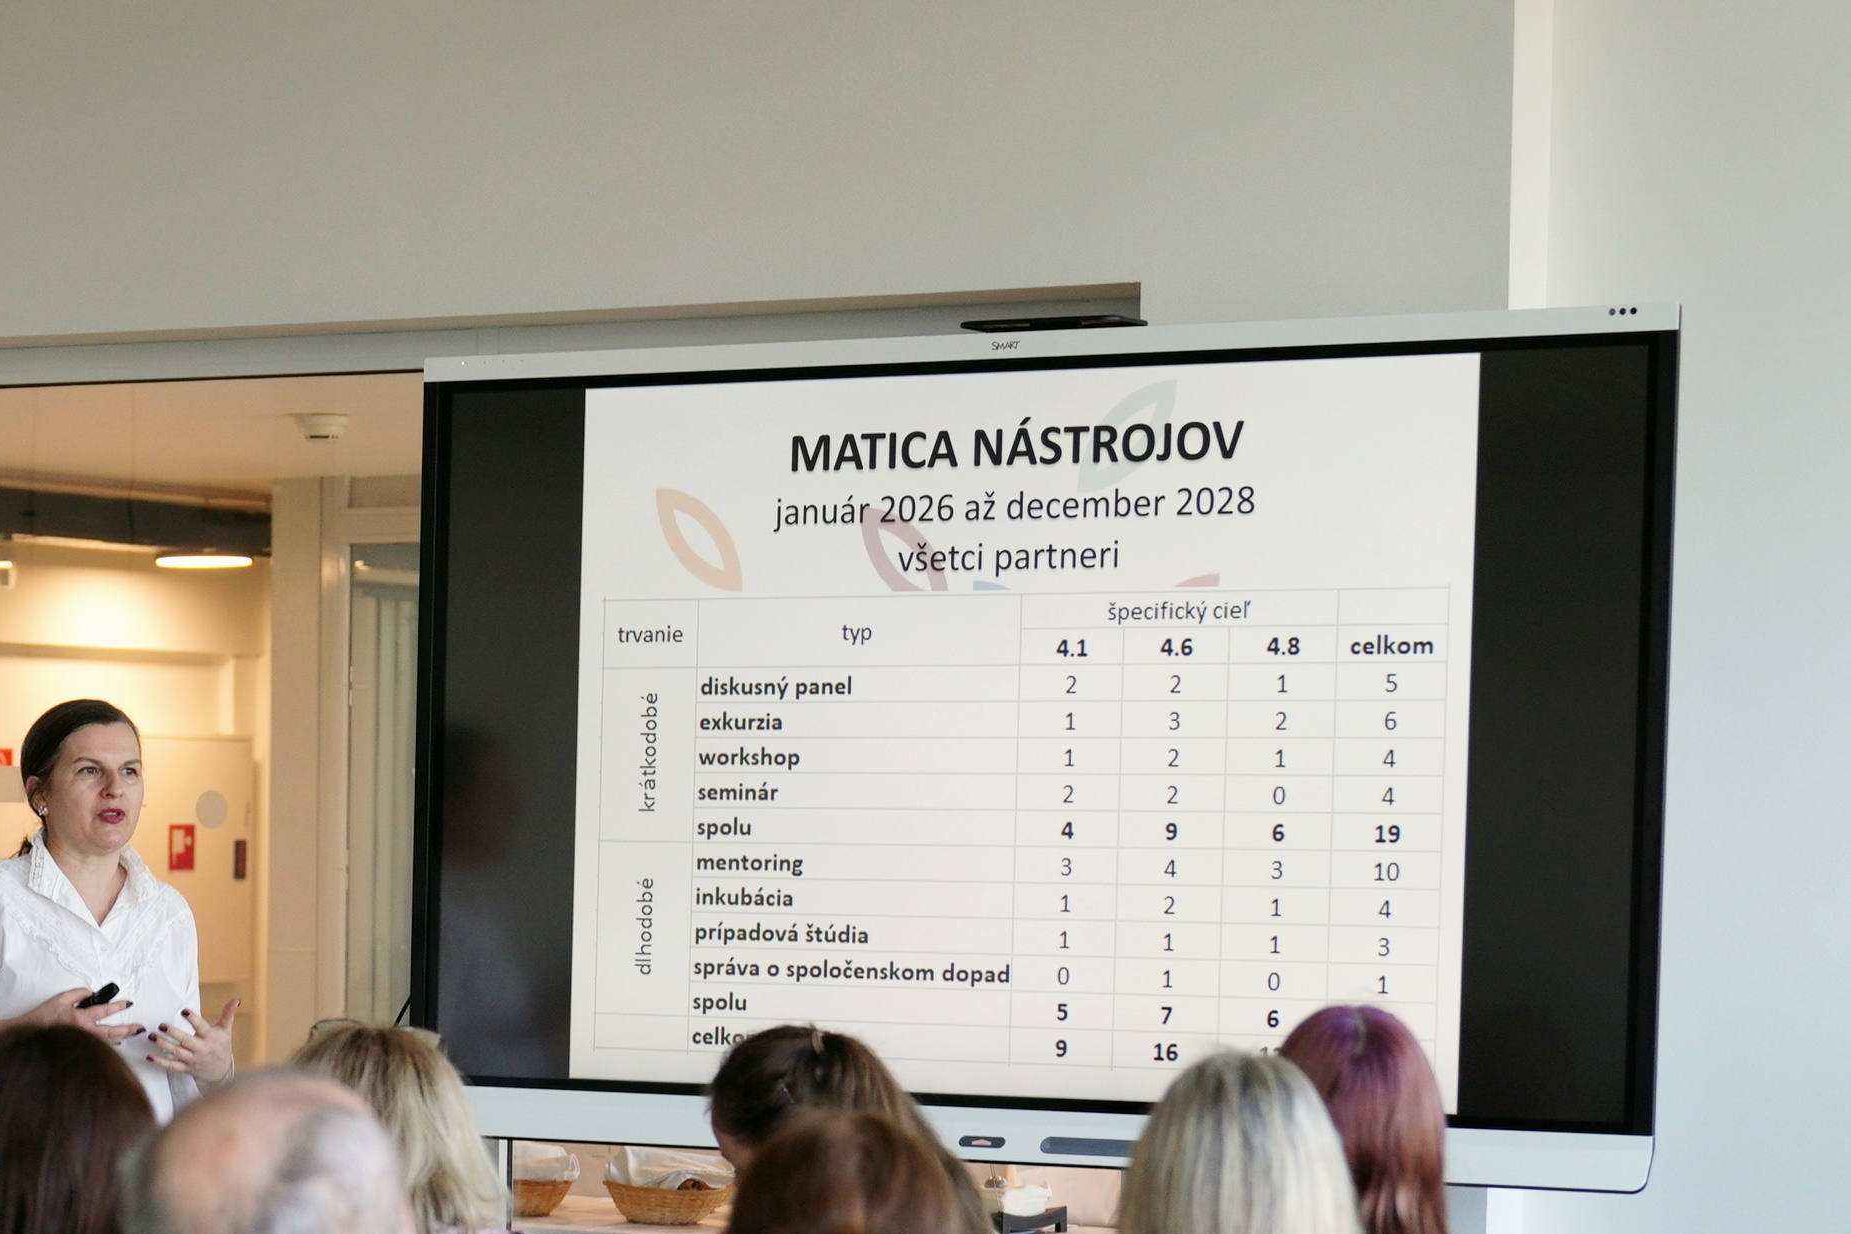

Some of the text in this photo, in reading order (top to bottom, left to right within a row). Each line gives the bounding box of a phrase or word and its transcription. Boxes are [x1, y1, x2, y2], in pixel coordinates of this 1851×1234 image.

[991, 340, 1021, 351] SMART
[790, 416, 1245, 473] MATICA NÁSTROJOV
[772, 485, 1255, 534] január 2026 až december 2028
[897, 539, 1119, 578] všetci partneri
[1107, 597, 1253, 626] špecifický cieľ
[617, 624, 874, 647] trvanie typ
[1055, 633, 1434, 658] 4.1 4.6 4.8 celkom
[700, 673, 1398, 701] diskusný panel 2 2 1 5
[699, 710, 1397, 731] exkurzia 1 3 2 6
[637, 691, 658, 813] krátkodobé
[698, 745, 1397, 771] workshop 1 2 1 4
[697, 781, 1395, 806] seminár 2 2 0 4
[696, 816, 1401, 844] spolu 4 9 6 19
[696, 853, 1400, 882] mentoring 3 4 3 10
[695, 886, 1392, 919] inkubácia 1 2 1 4
[633, 876, 654, 976] dlhodobé
[694, 920, 1390, 957] prípadová štúdia 1 1 1 3
[693, 956, 1389, 995] správa o spoločenskom dopad 0 1 0 1
[692, 991, 1280, 1029] spolu 5 7 6
[691, 1025, 1179, 1062] celko 9 16
